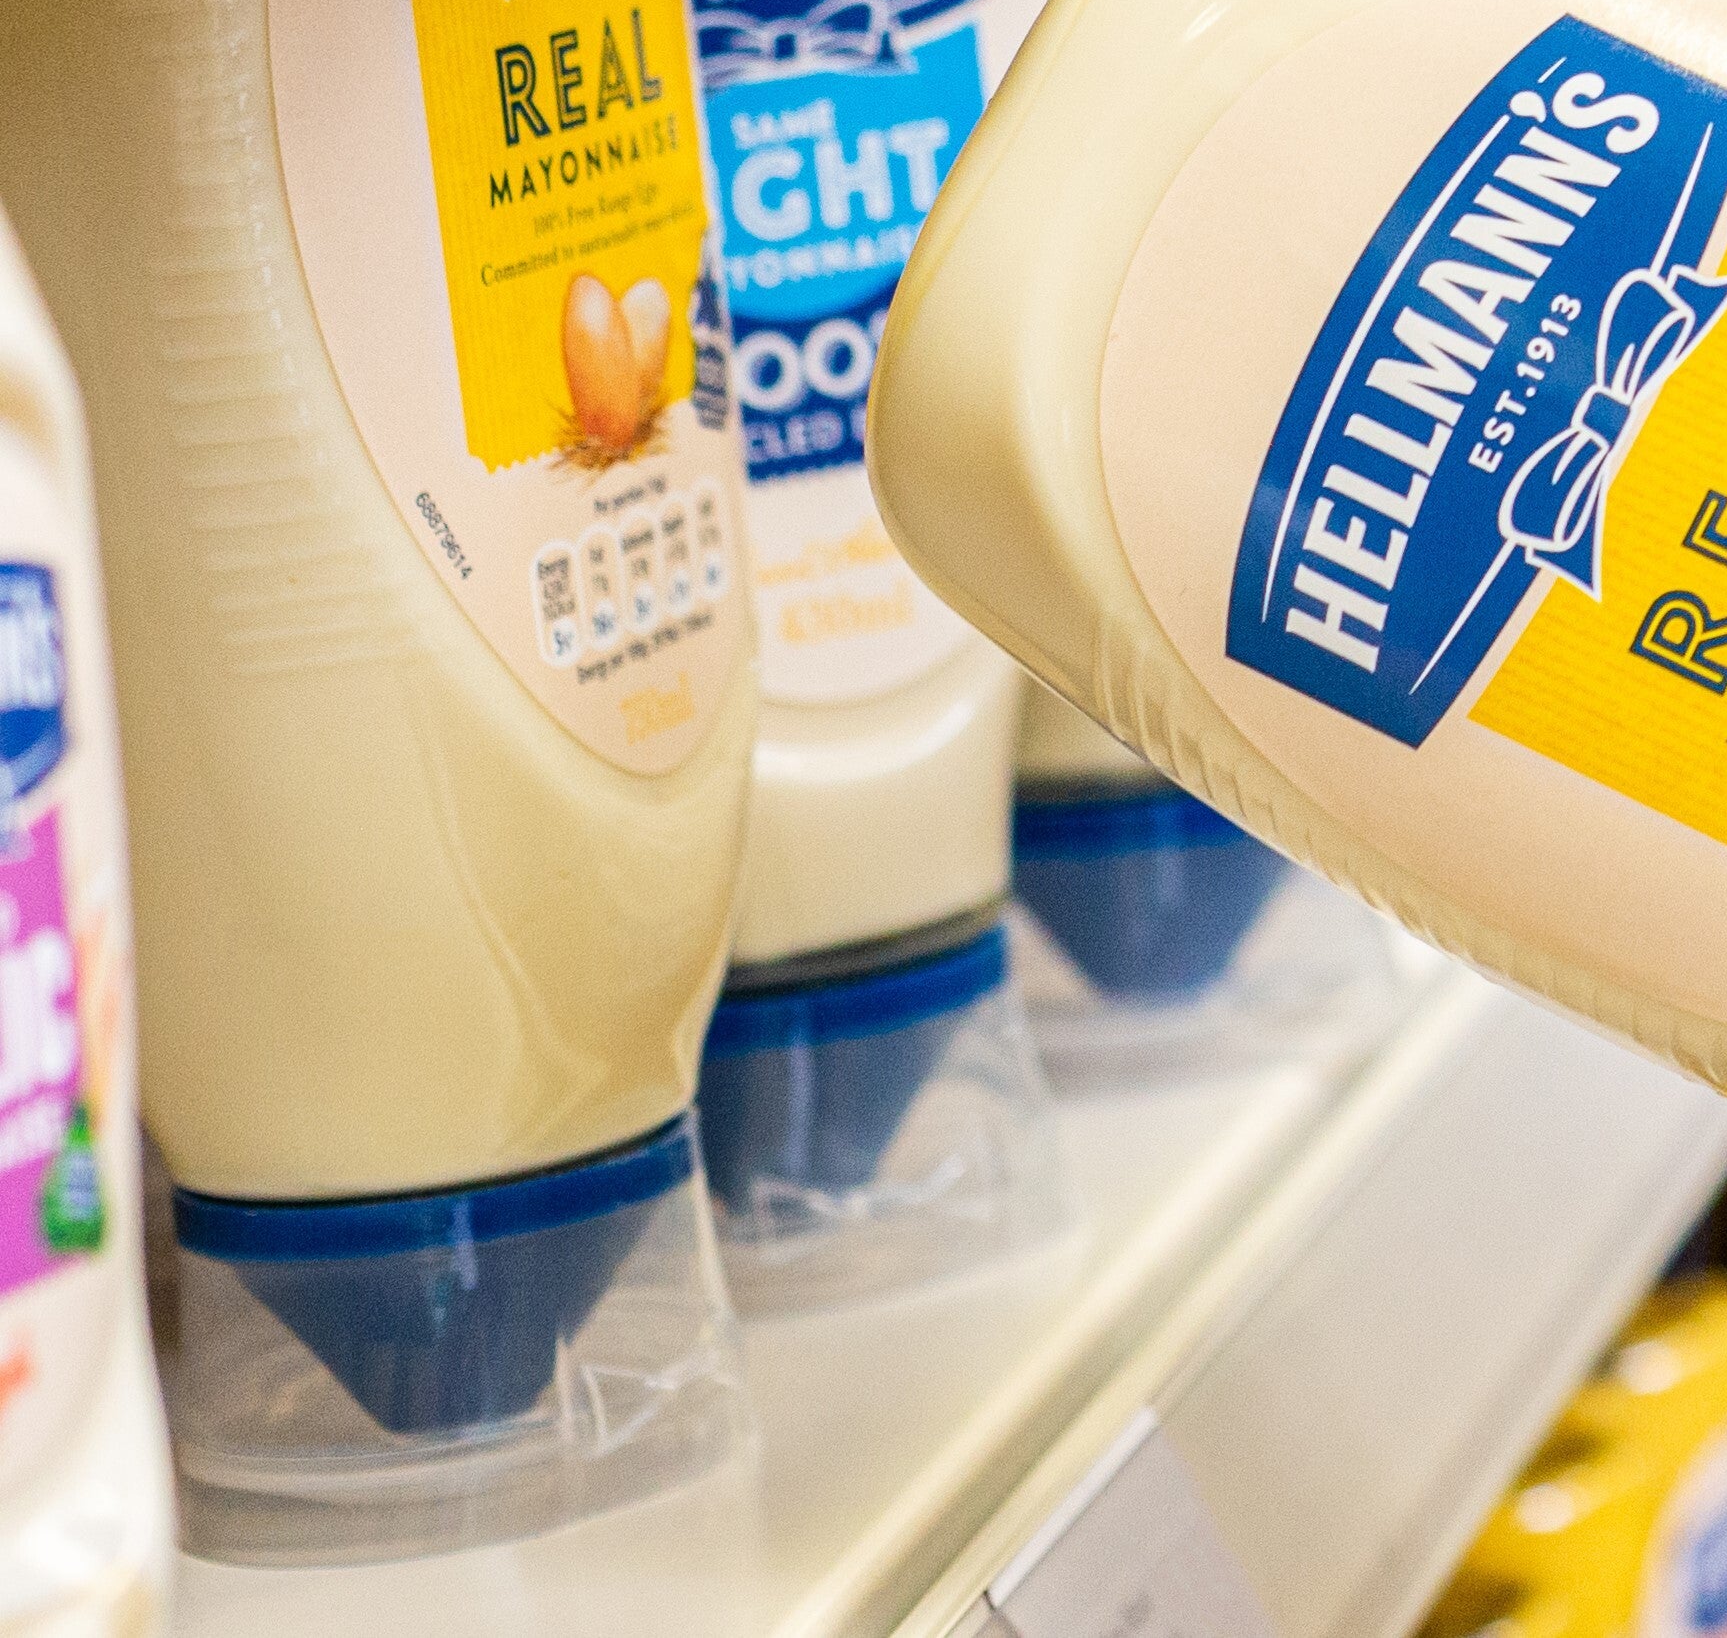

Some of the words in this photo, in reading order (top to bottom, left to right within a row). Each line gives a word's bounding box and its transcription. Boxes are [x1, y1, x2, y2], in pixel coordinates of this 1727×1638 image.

[495, 6, 662, 148] REAL
[488, 112, 679, 209] MAYONNAISE
[731, 116, 950, 242] GHT
[1284, 73, 1661, 674] HELLMANN'S
[1467, 292, 1582, 474] EST.1913
[416, 492, 473, 580] 68879614
